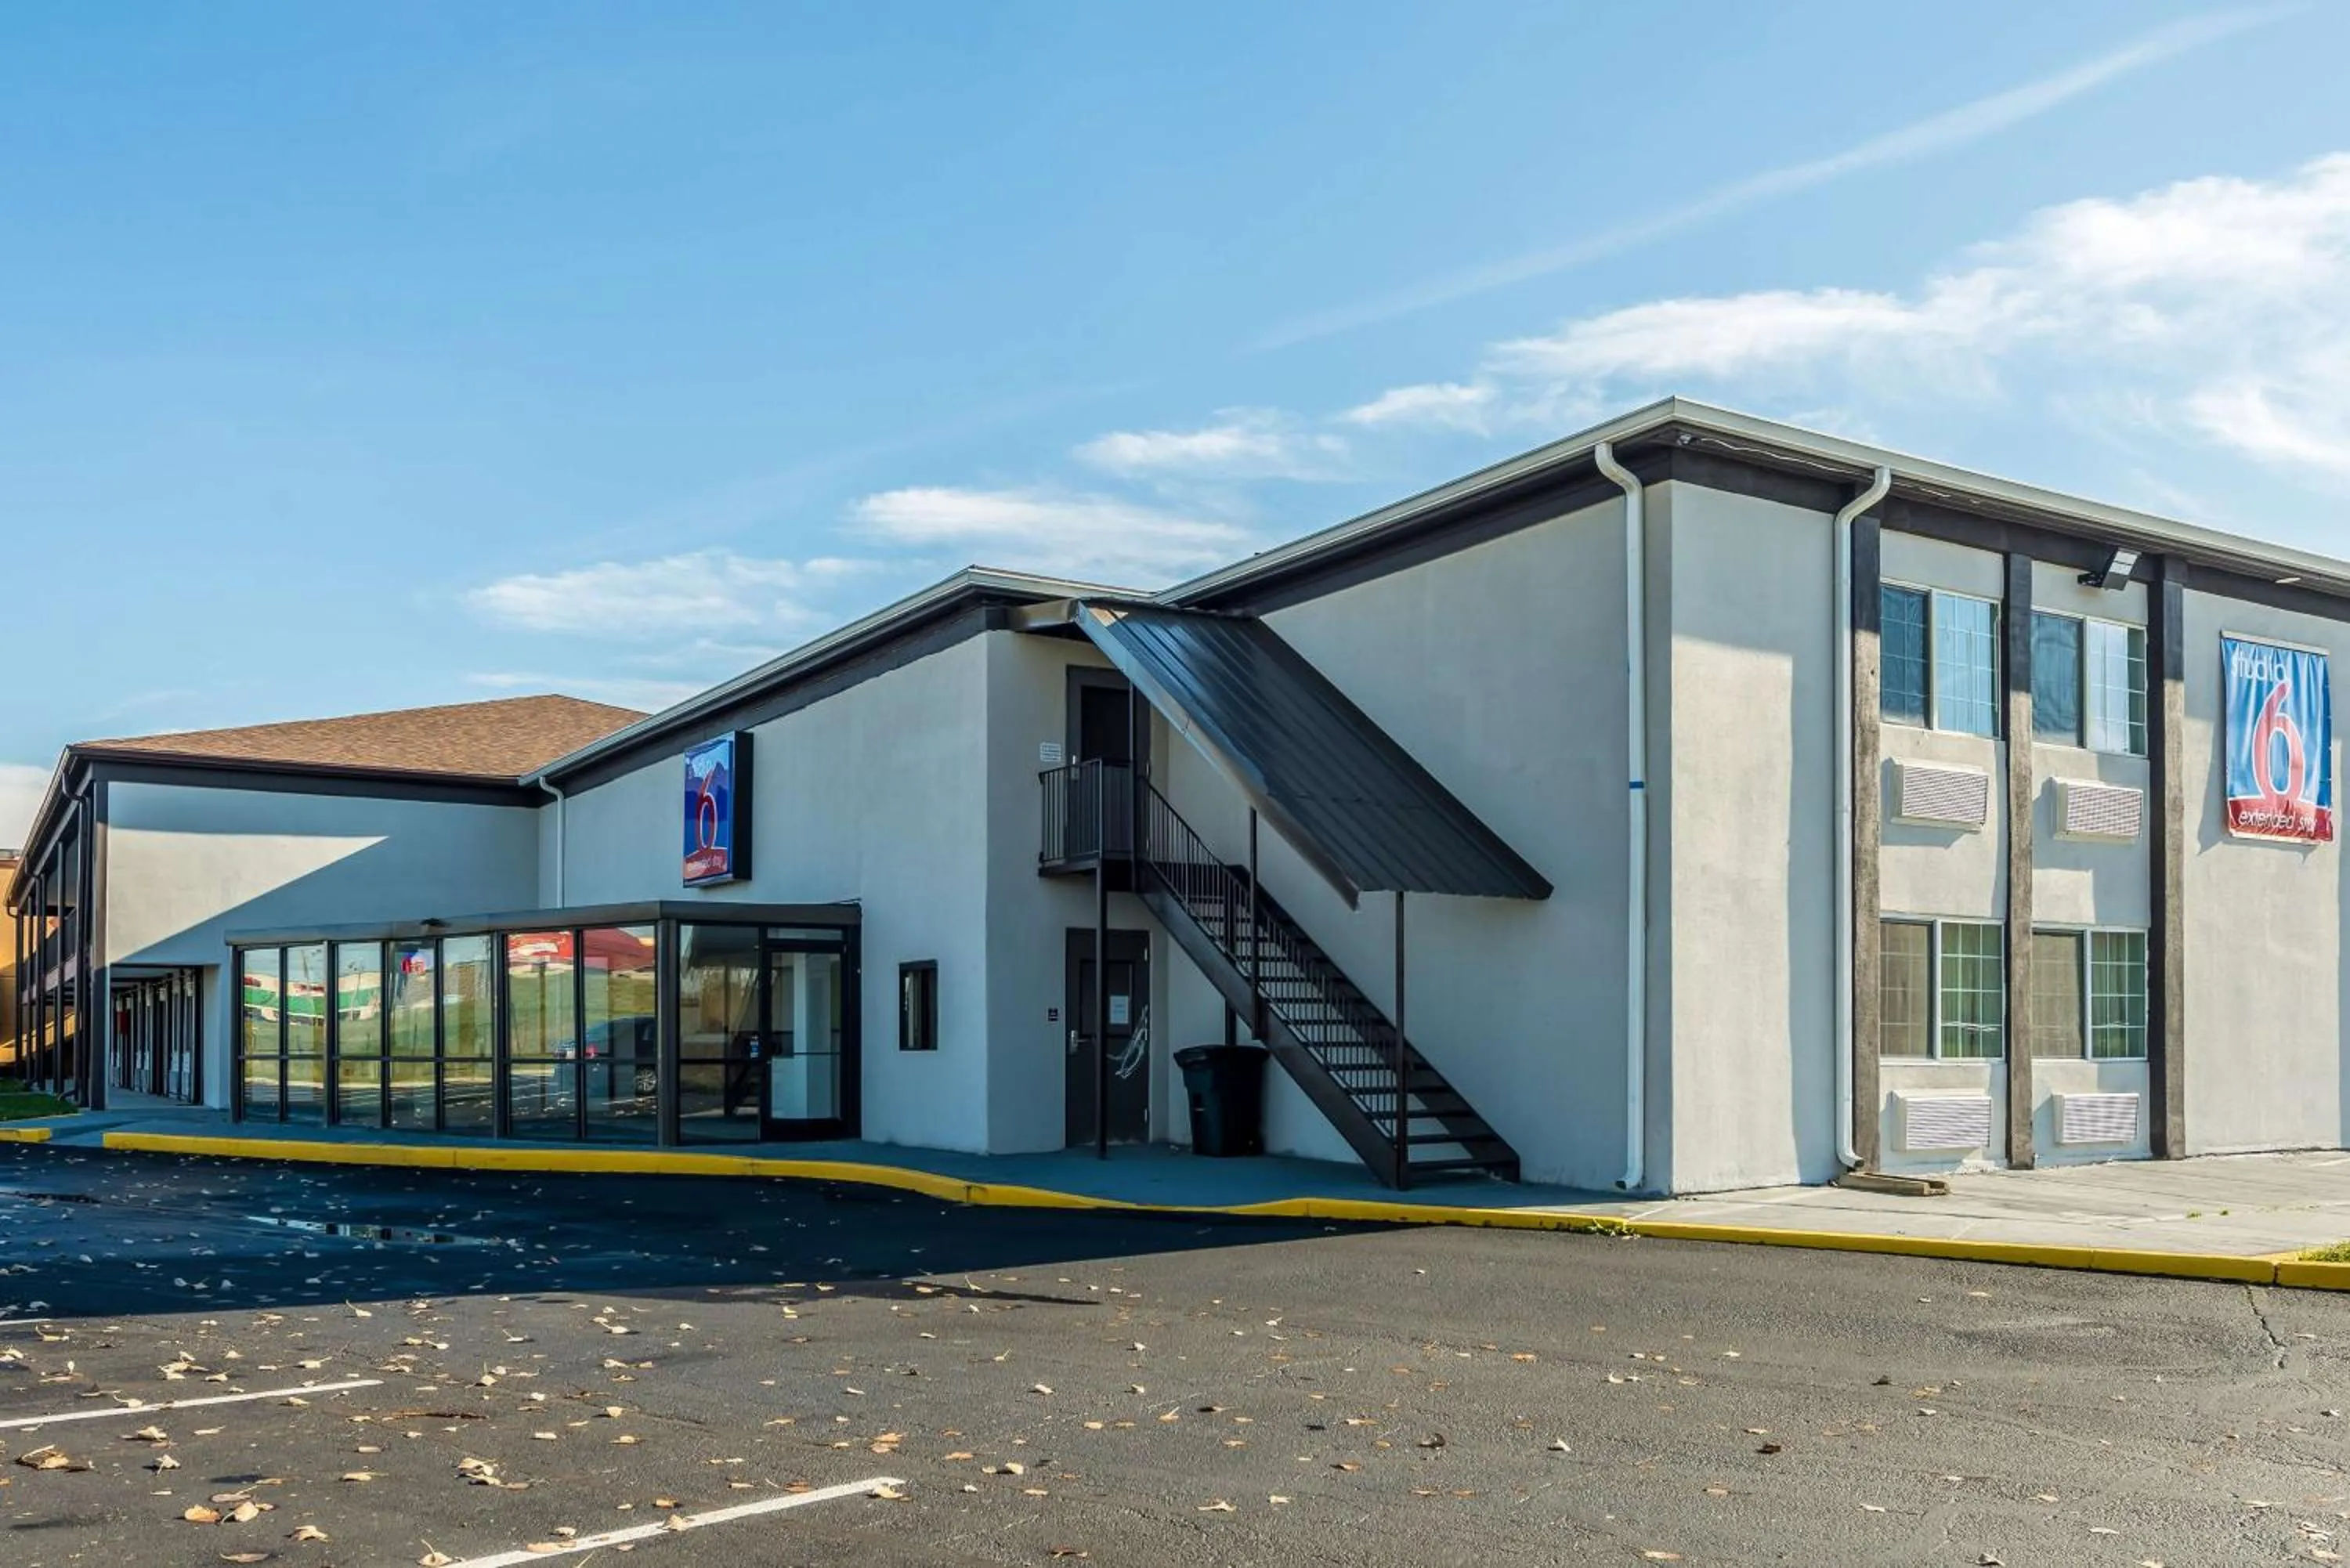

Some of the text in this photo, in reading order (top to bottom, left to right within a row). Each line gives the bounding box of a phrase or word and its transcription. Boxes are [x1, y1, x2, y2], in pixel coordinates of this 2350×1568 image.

[2252, 679, 2306, 800] 6
[695, 767, 718, 850] 6
[2238, 808, 2296, 829] extended
